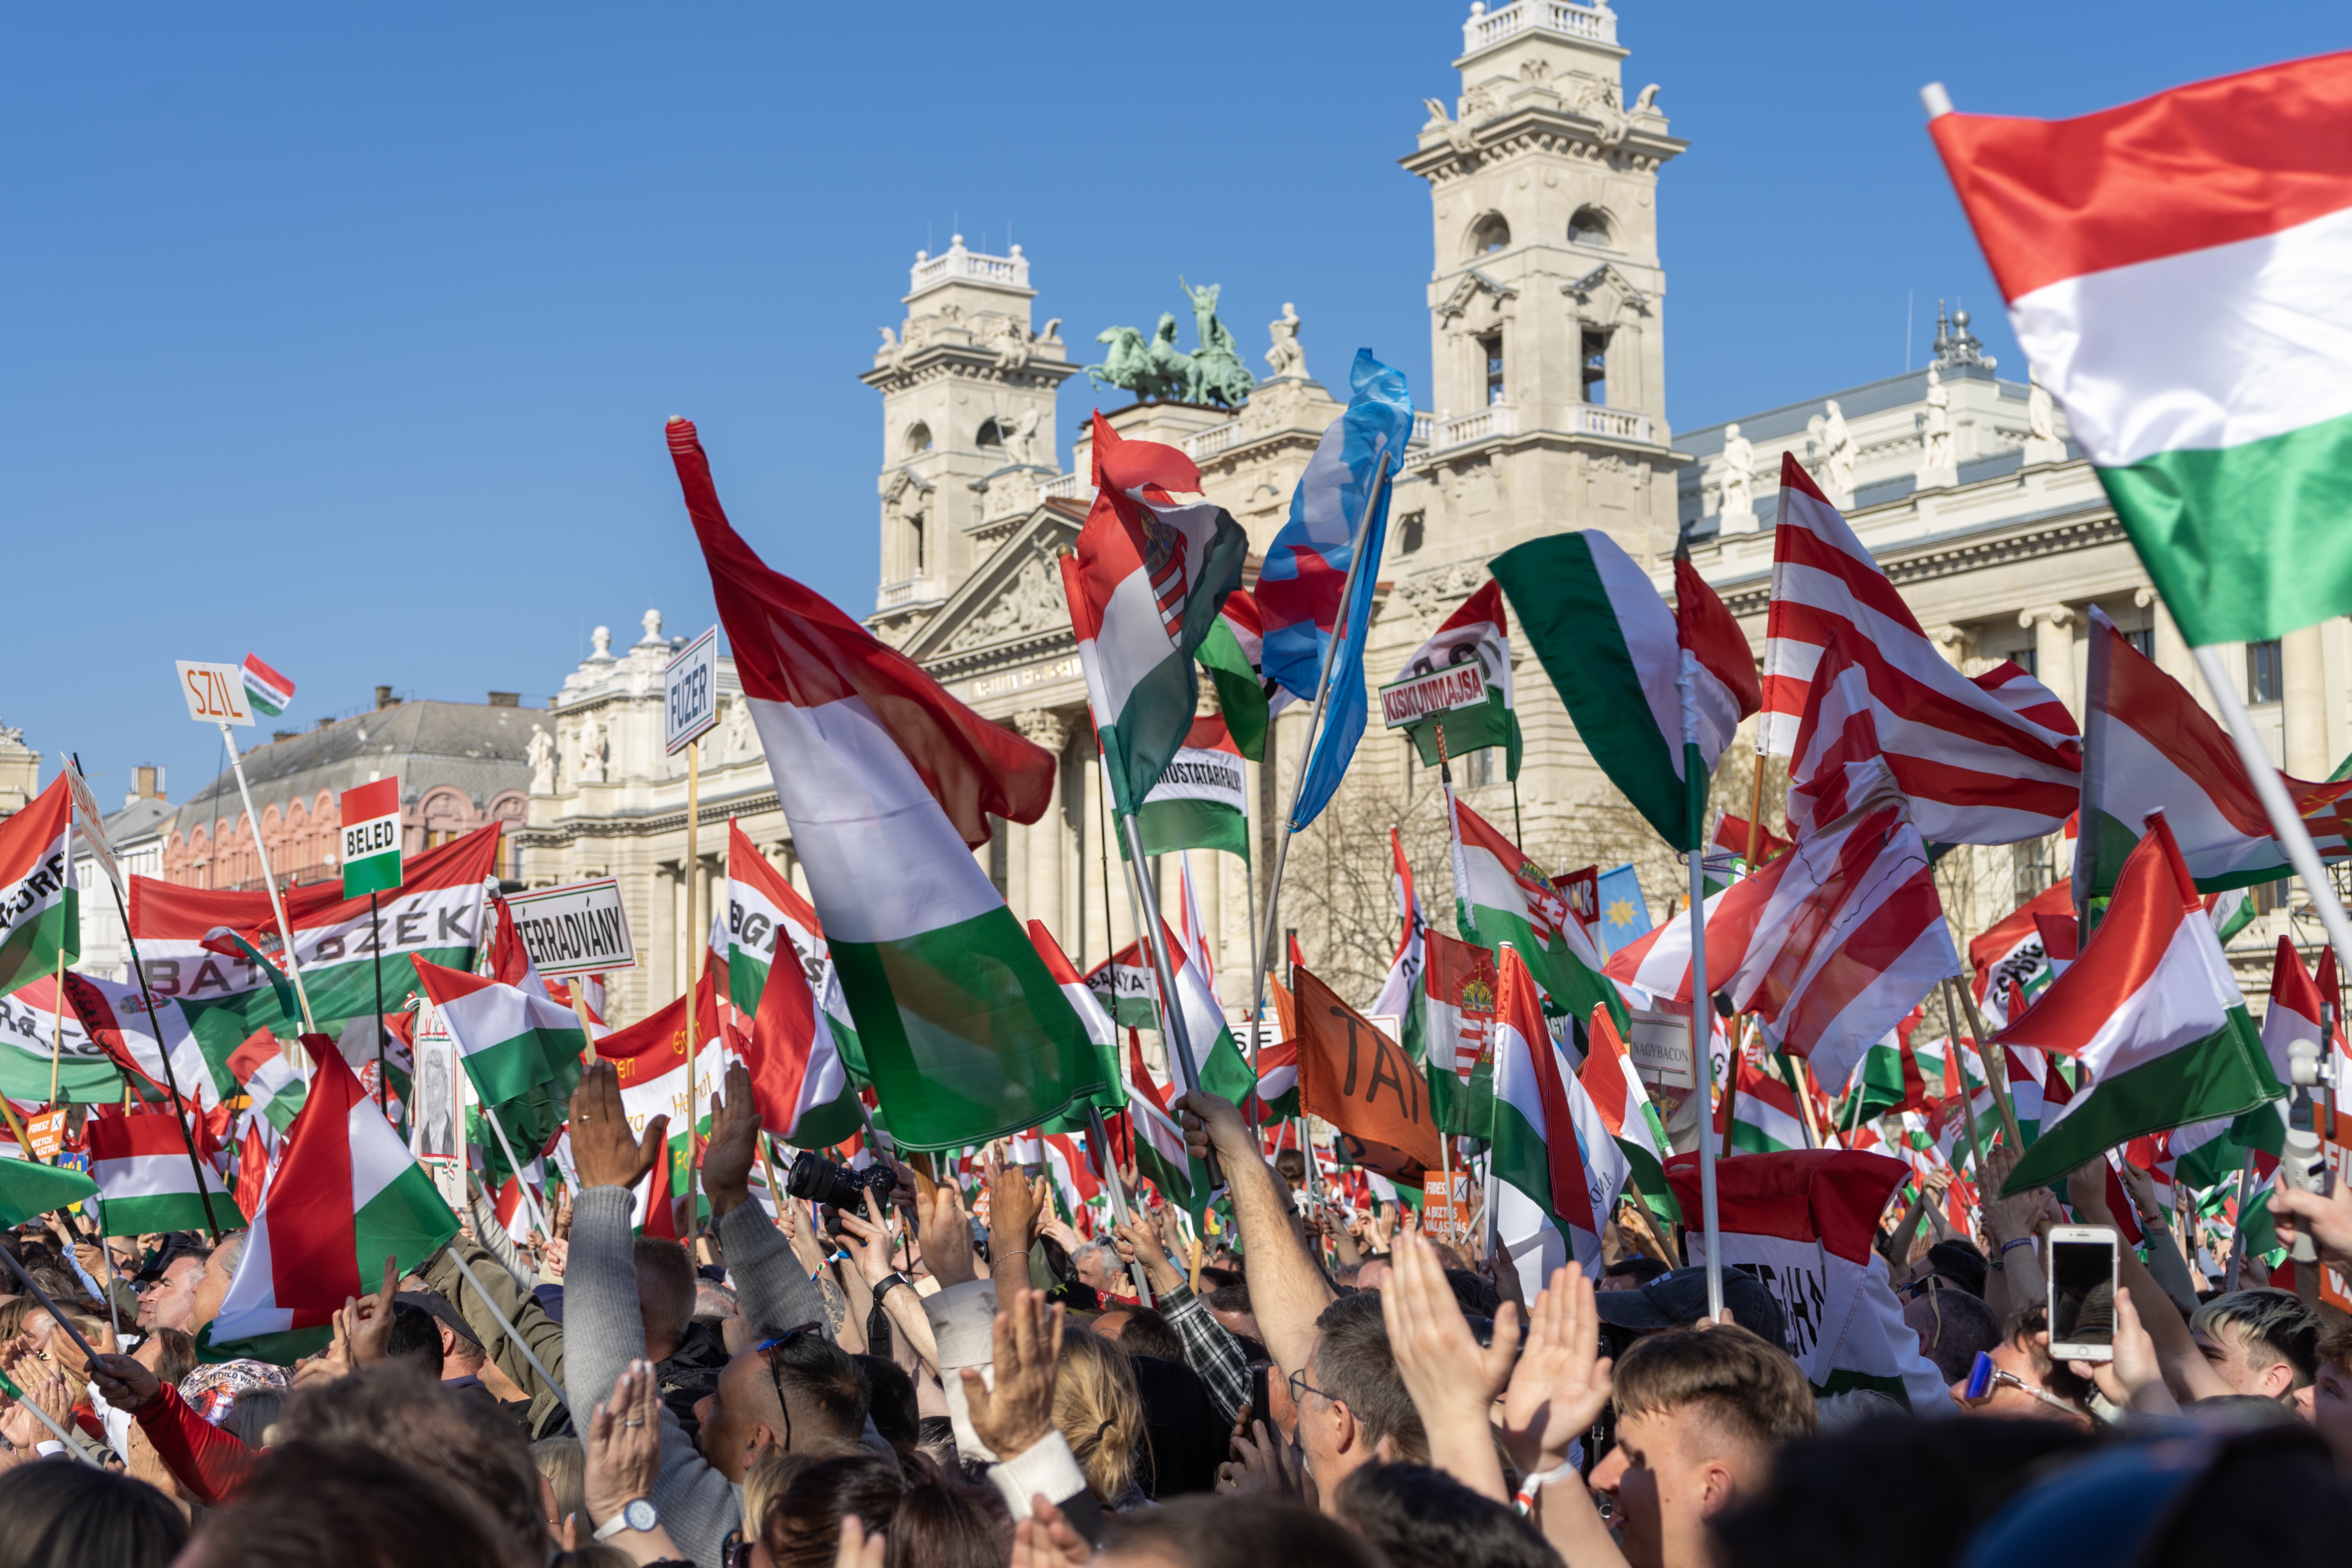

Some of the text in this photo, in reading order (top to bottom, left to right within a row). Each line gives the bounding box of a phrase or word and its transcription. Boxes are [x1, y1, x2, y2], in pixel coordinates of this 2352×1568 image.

[187, 670, 243, 718] SZIL
[671, 653, 707, 734] FÜZÉR
[1383, 668, 1484, 722] KISKUNMAJSA
[347, 820, 394, 857] BELED
[1633, 1041, 1688, 1062] NAGYBACON
[672, 1071, 712, 1118] Hemat
[28, 1120, 50, 1134] FIDESZ
[31, 1135, 53, 1147] BIZTOS
[36, 1142, 59, 1156] ASZTÁS
[1432, 1206, 1457, 1219] BIZTS
[209, 1372, 238, 1380] WORLD
[216, 1402, 234, 1410] HUNGAR
